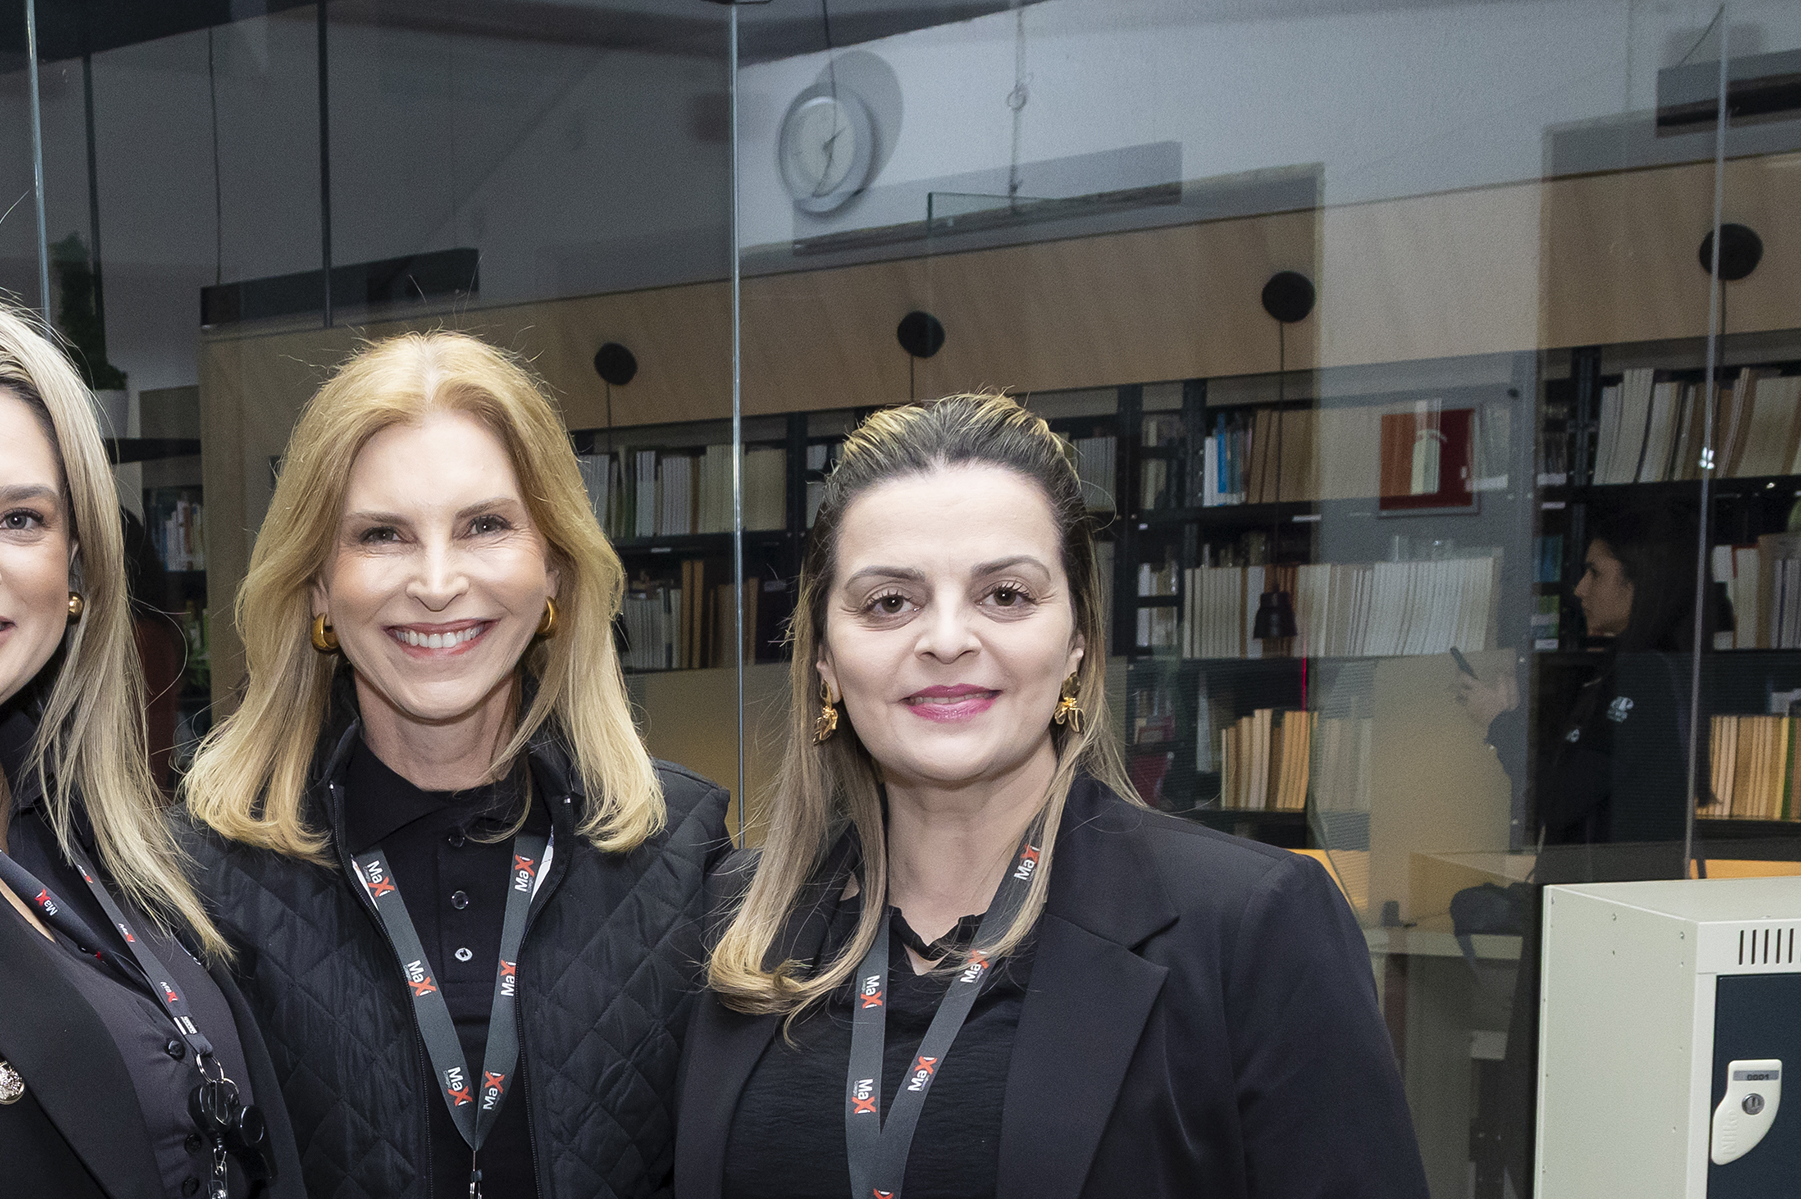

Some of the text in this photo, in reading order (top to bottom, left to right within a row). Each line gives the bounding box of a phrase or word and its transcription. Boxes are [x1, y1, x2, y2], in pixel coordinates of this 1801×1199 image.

[367, 860, 395, 898] MaXi
[514, 854, 535, 893] MaXi
[407, 959, 437, 997] MaXi
[500, 958, 517, 997] MaXi
[861, 974, 884, 1010] MaXi
[447, 1066, 473, 1106] MaXi
[482, 1070, 504, 1110] MaXi
[908, 1055, 938, 1092] MaXi
[852, 1077, 877, 1114] MaXi
